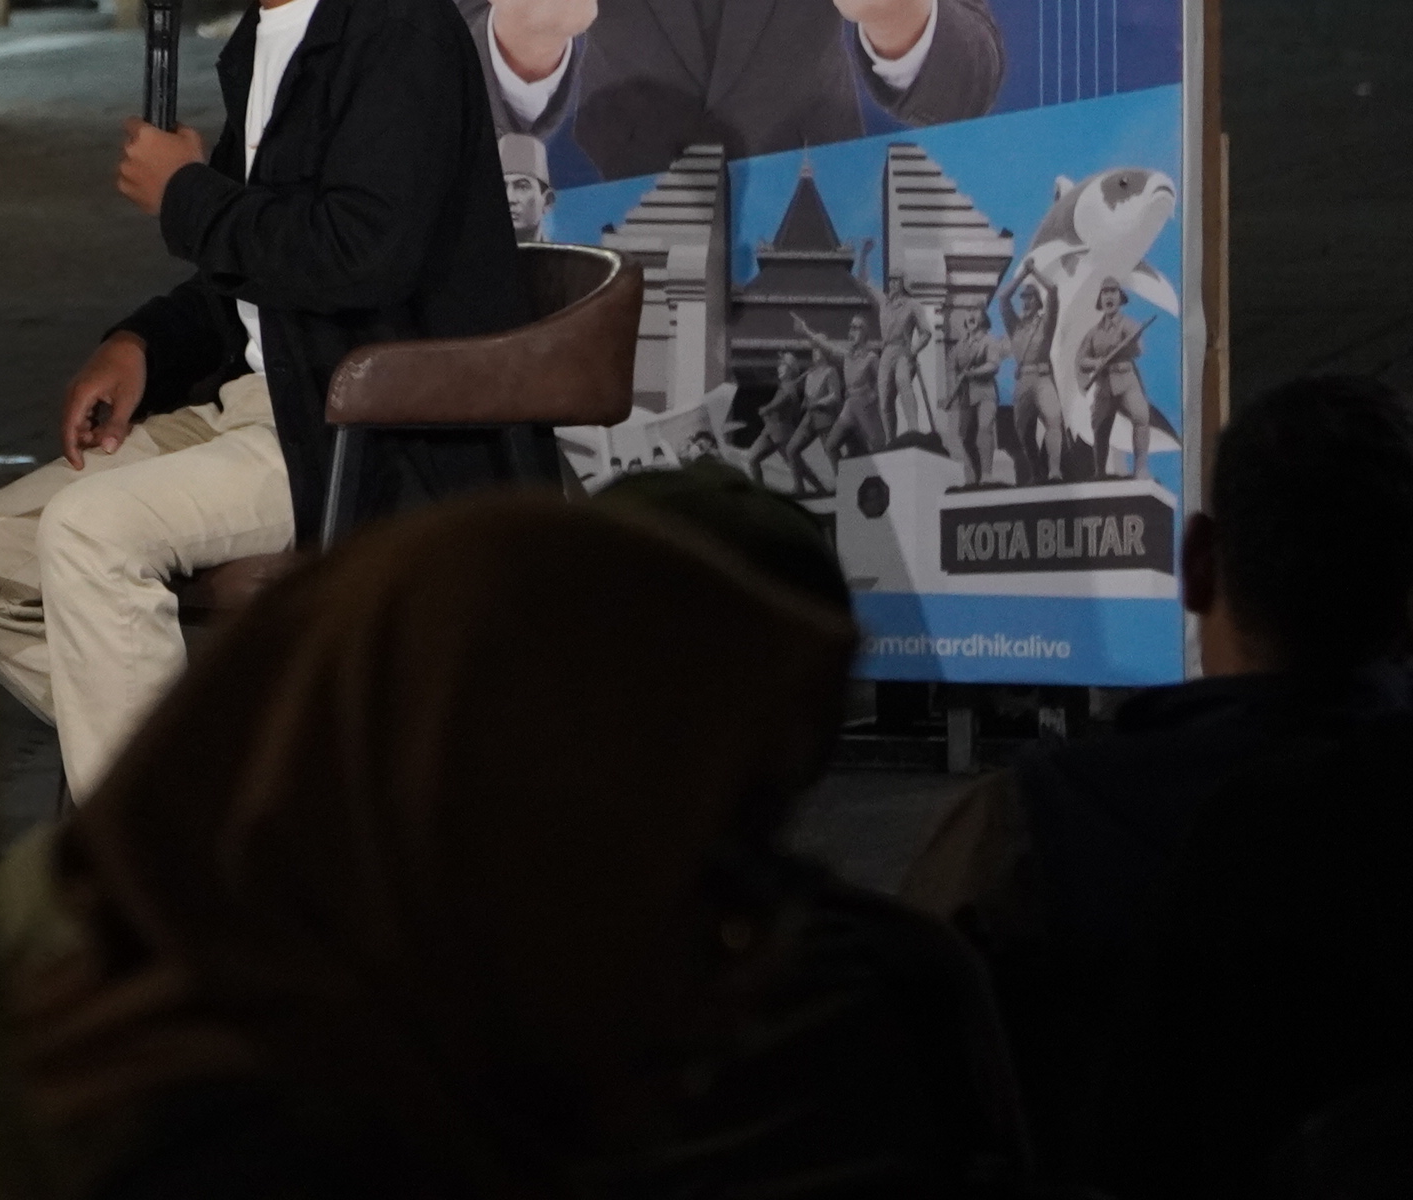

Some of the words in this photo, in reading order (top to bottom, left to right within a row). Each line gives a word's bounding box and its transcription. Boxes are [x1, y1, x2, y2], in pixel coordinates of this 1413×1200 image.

[957, 520, 1030, 560] KOTA
[1037, 514, 1145, 558] BLITAR
[865, 633, 1072, 659] mahardhikalive
